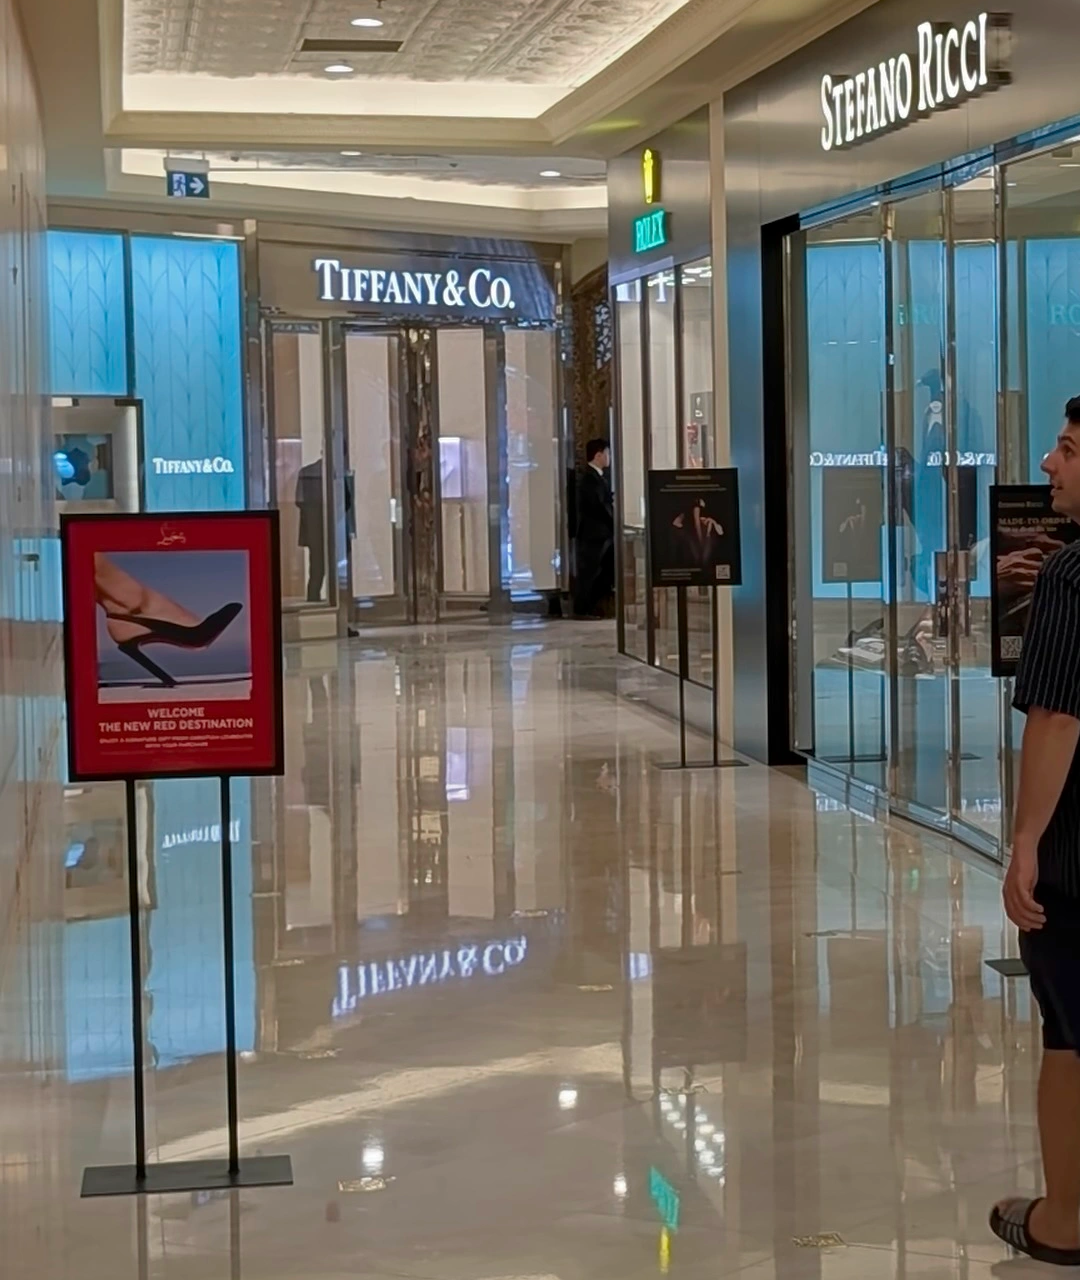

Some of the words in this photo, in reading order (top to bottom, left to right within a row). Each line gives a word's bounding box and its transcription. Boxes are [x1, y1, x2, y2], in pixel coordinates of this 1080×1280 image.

[820, 53, 912, 151] STEFANO
[917, 12, 988, 111] RICCI
[147, 707, 205, 718] WELCOME
[99, 722, 121, 733] THE
[123, 720, 151, 732] NEW
[153, 720, 176, 731] RED
[179, 718, 253, 730] DESTINATION
